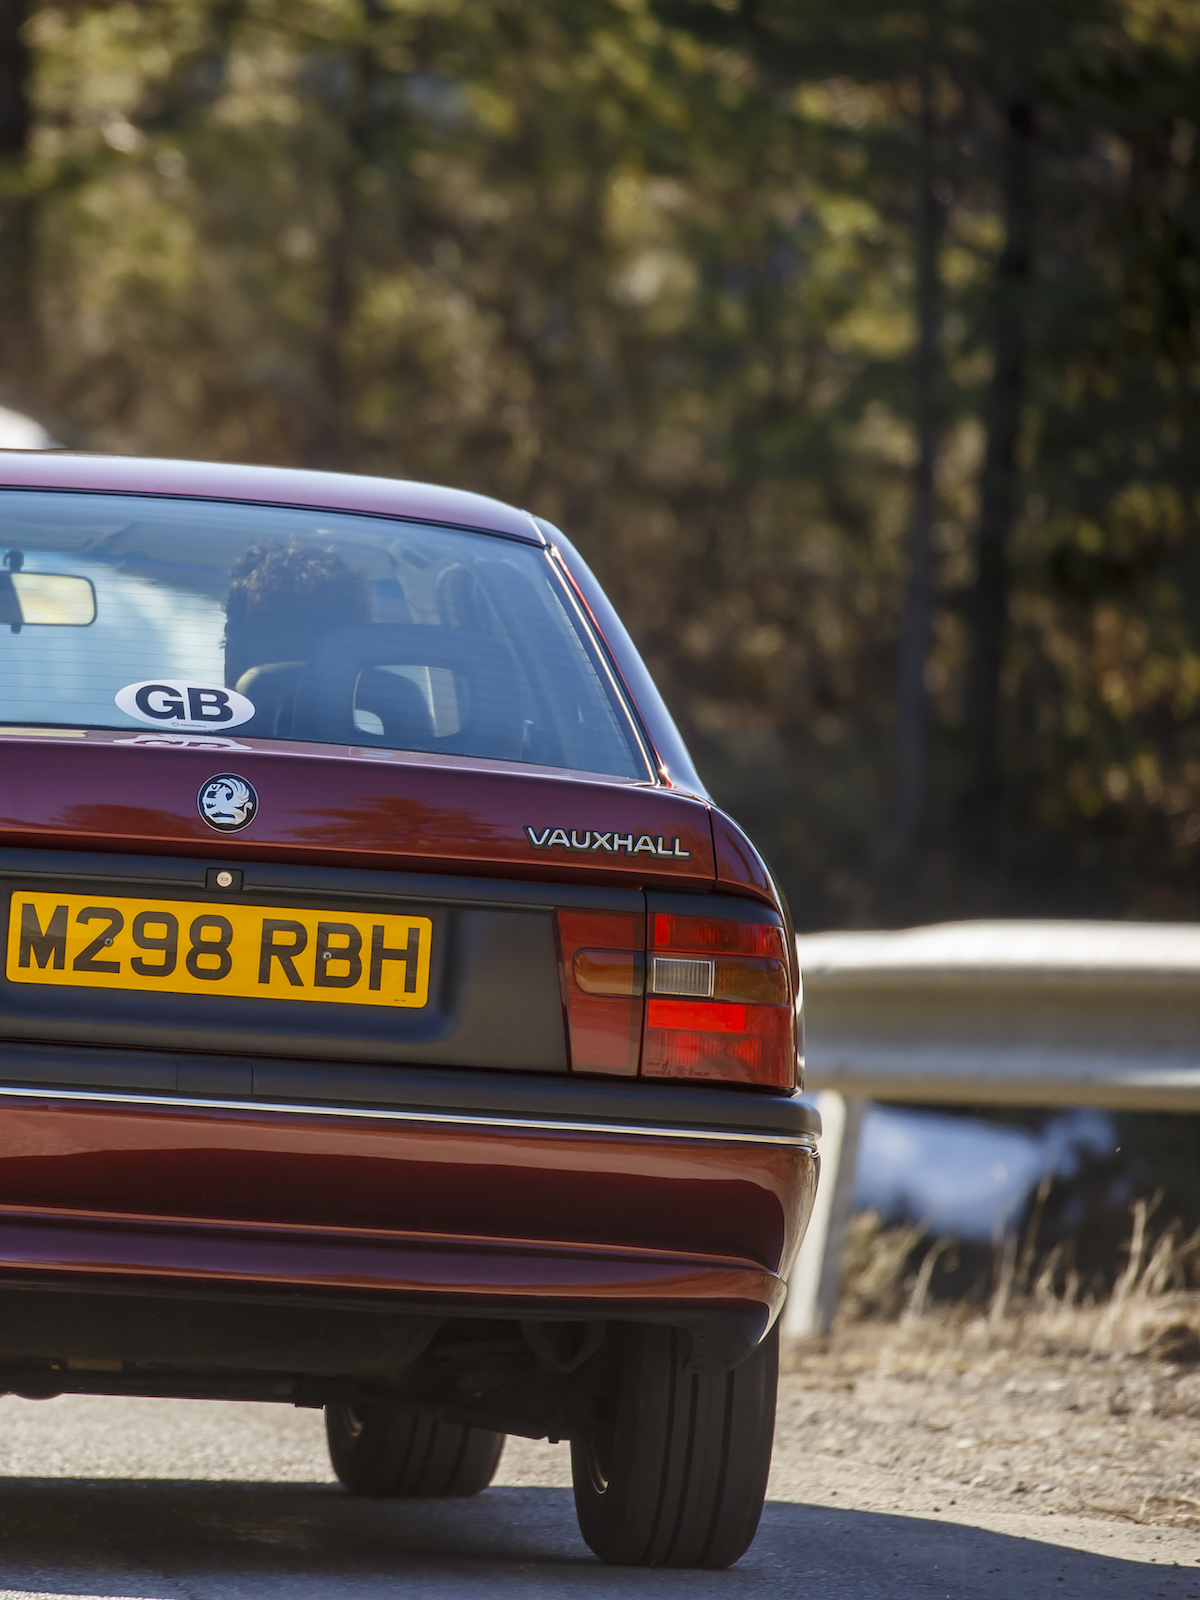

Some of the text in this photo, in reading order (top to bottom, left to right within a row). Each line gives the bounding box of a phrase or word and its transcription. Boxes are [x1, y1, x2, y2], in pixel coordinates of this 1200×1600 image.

[136, 685, 233, 722] GB
[527, 826, 690, 857] VAUXHALL
[17, 902, 421, 994] M298 RBH
